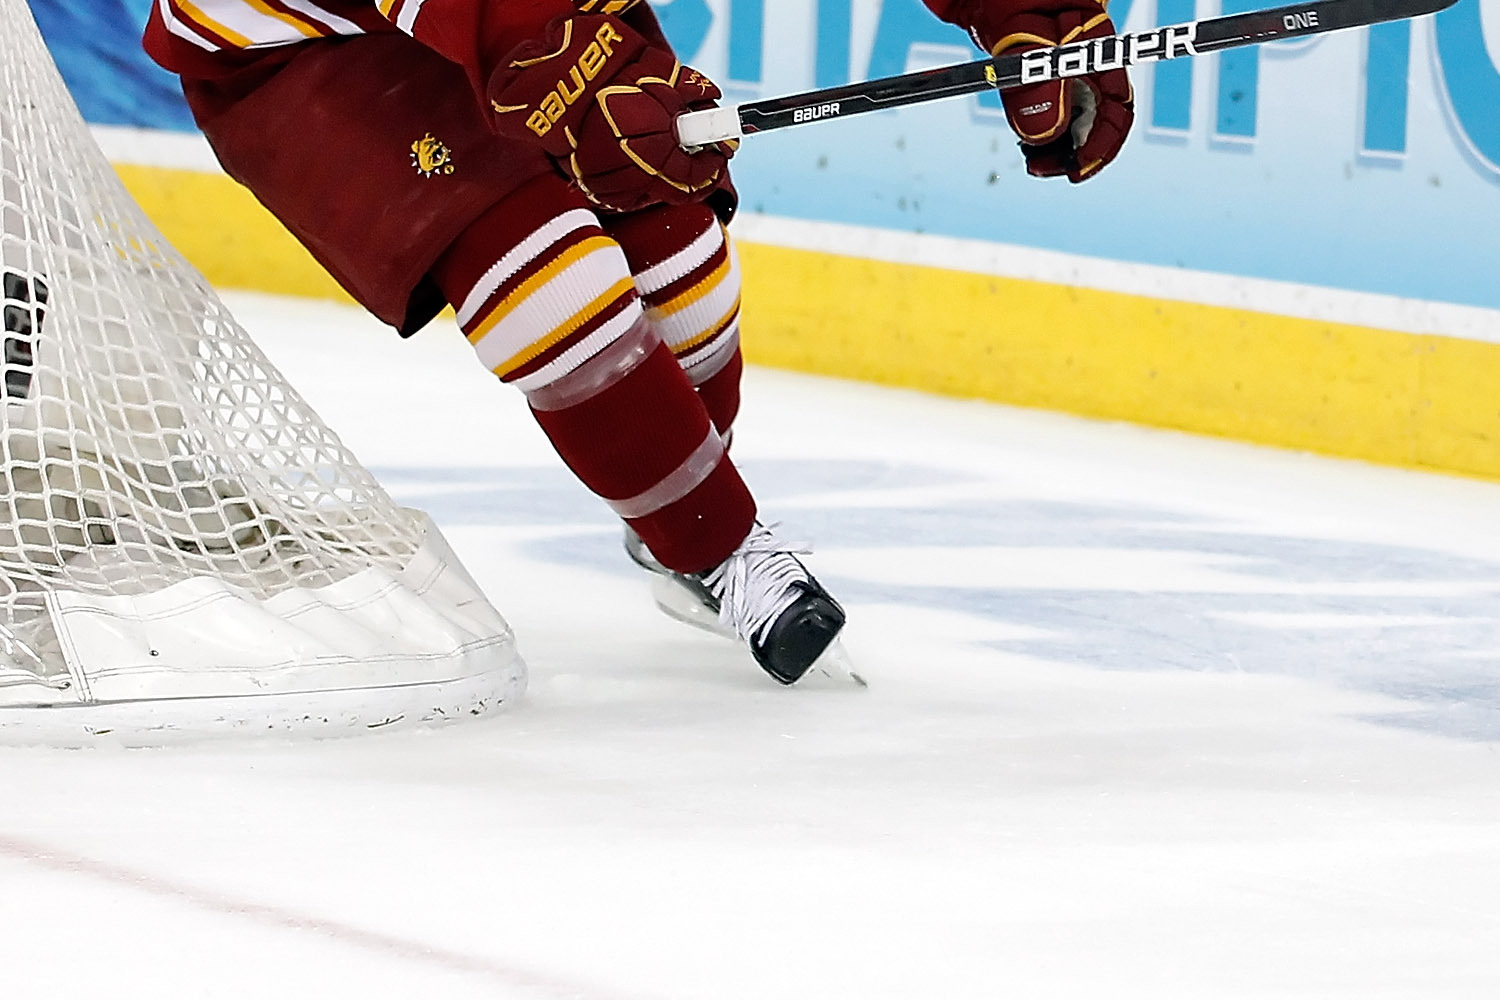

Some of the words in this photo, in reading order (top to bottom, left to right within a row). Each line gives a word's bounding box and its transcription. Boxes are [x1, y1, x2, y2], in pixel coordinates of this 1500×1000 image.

[525, 20, 624, 138] BAUER
[1021, 20, 1200, 85] BAUER
[1283, 10, 1320, 31] ONE
[793, 102, 841, 123] BAUER
